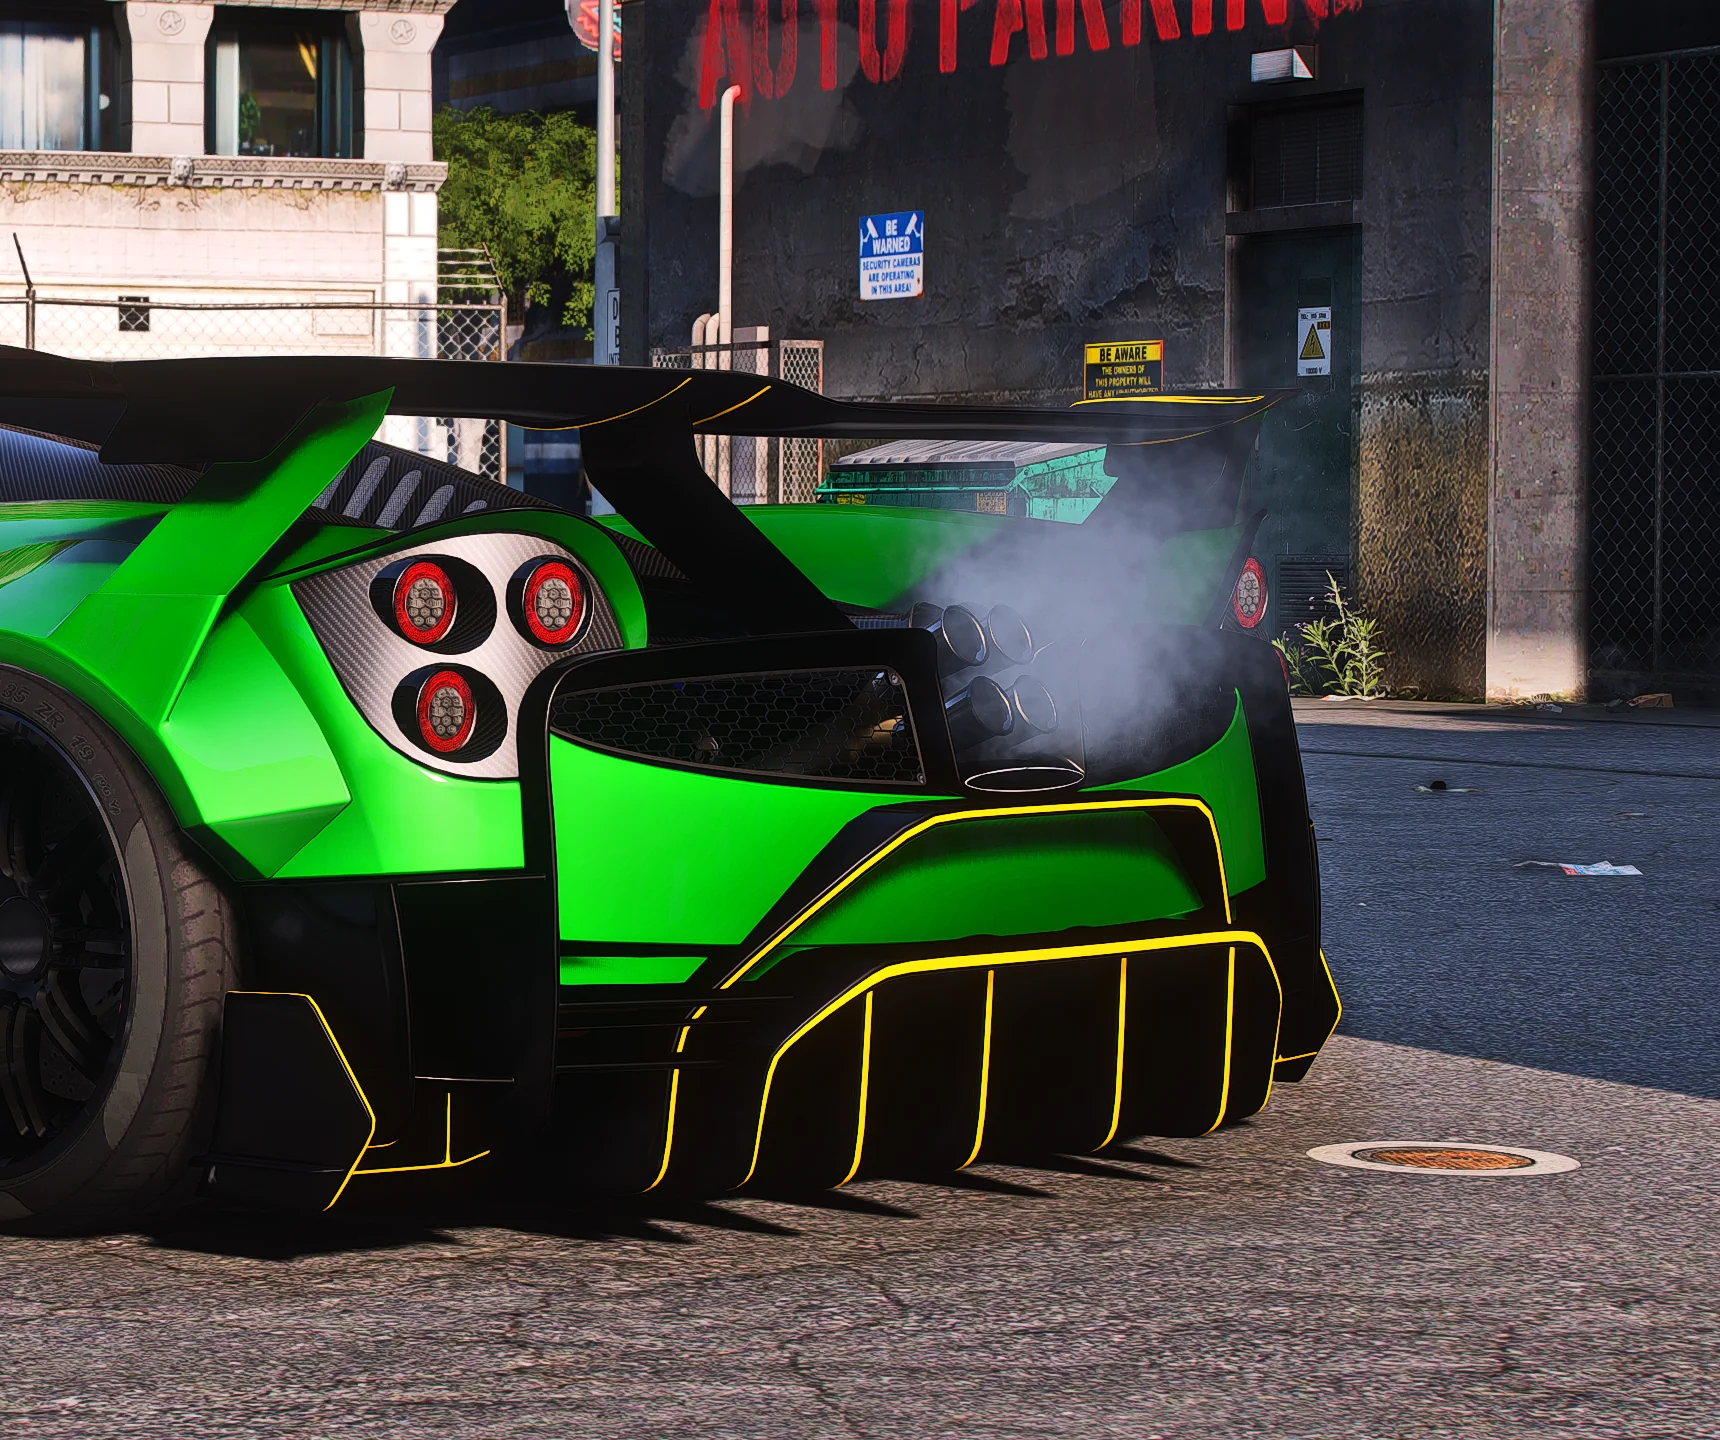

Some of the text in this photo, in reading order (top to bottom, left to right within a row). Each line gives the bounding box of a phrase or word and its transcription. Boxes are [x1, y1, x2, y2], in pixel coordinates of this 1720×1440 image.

[886, 219, 897, 236] BE
[872, 236, 911, 255] WARNED
[862, 255, 921, 271] SECURITY CAMERAS
[868, 269, 915, 282] ARE OPERATING
[871, 282, 912, 295] IN THIS AREA!
[1099, 346, 1147, 362] BE AWARE
[1101, 366, 1113, 375] THE
[1138, 365, 1145, 374] OF
[1095, 377, 1108, 387] THIS
[1108, 376, 1138, 387] PROPERTY
[0, 681, 31, 706] 35
[32, 699, 66, 731] ZR
[68, 733, 97, 763] 19
